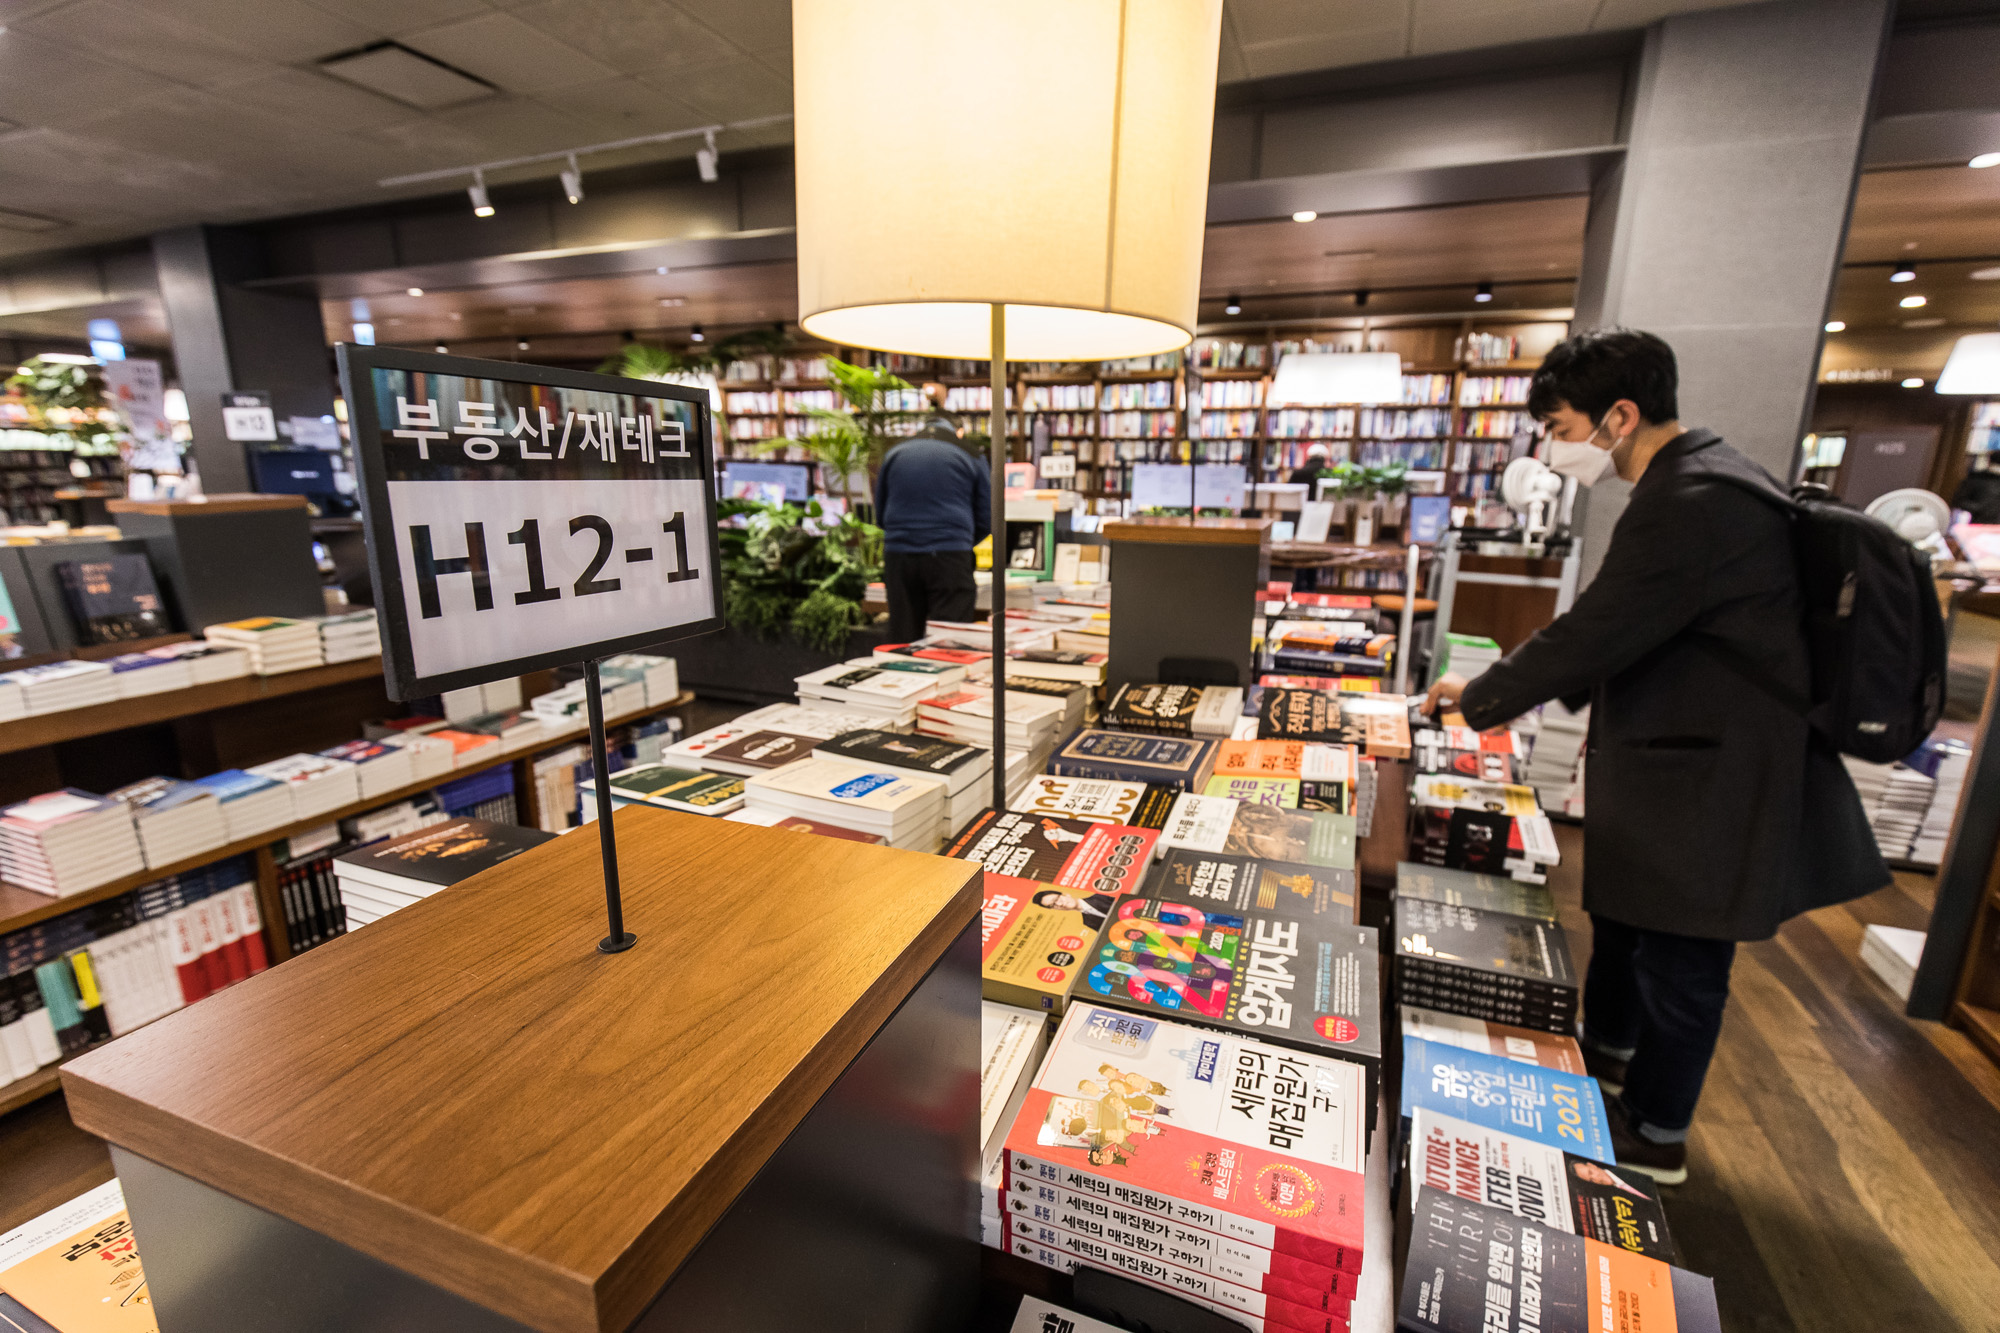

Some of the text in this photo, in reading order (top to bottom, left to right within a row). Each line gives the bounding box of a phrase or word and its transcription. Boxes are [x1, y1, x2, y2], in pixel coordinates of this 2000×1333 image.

[392, 396, 691, 464] 부동산/재테크
[409, 511, 700, 620] H12-1
[1000, 846, 1035, 877] 보인다
[1238, 919, 1299, 1029] 업계지도
[1086, 1012, 1117, 1041] 주식
[1110, 1018, 1132, 1045] 최단기간
[1197, 1042, 1219, 1082] 개미대학
[1231, 1048, 1272, 1121] 세력의
[1432, 1063, 1472, 1099] 금융
[1471, 1068, 1507, 1108] 영업
[1268, 1056, 1310, 1150] 매집원가
[1507, 1072, 1544, 1133] 트렌드
[1552, 1083, 1585, 1143] 2021
[1212, 1147, 1238, 1201] 베스트셀러
[1425, 1134, 1450, 1192] UTURE
[1455, 1137, 1482, 1203] INANCE
[1487, 1166, 1513, 1214] FTER
[1066, 1196, 1108, 1219] 세력의
[1113, 1206, 1171, 1238] 매집원가
[1175, 1229, 1211, 1250] 구하기
[1067, 1173, 1110, 1196] 세력의
[1115, 1184, 1173, 1215] 매집원가
[1178, 1206, 1215, 1226] 구하기
[1517, 1176, 1546, 1222] OVID
[1061, 1214, 1103, 1238] 세력의
[1108, 1226, 1165, 1257] 매집원가
[1168, 1247, 1204, 1268] 구하기
[1066, 1238, 1107, 1261] 세력의
[1112, 1250, 1168, 1281] 매집원가
[1172, 1272, 1208, 1293] 구하기
[1488, 1239, 1515, 1279] 알면
[1520, 1226, 1545, 1274] 보인다
[1518, 1270, 1543, 1321] 미래가
